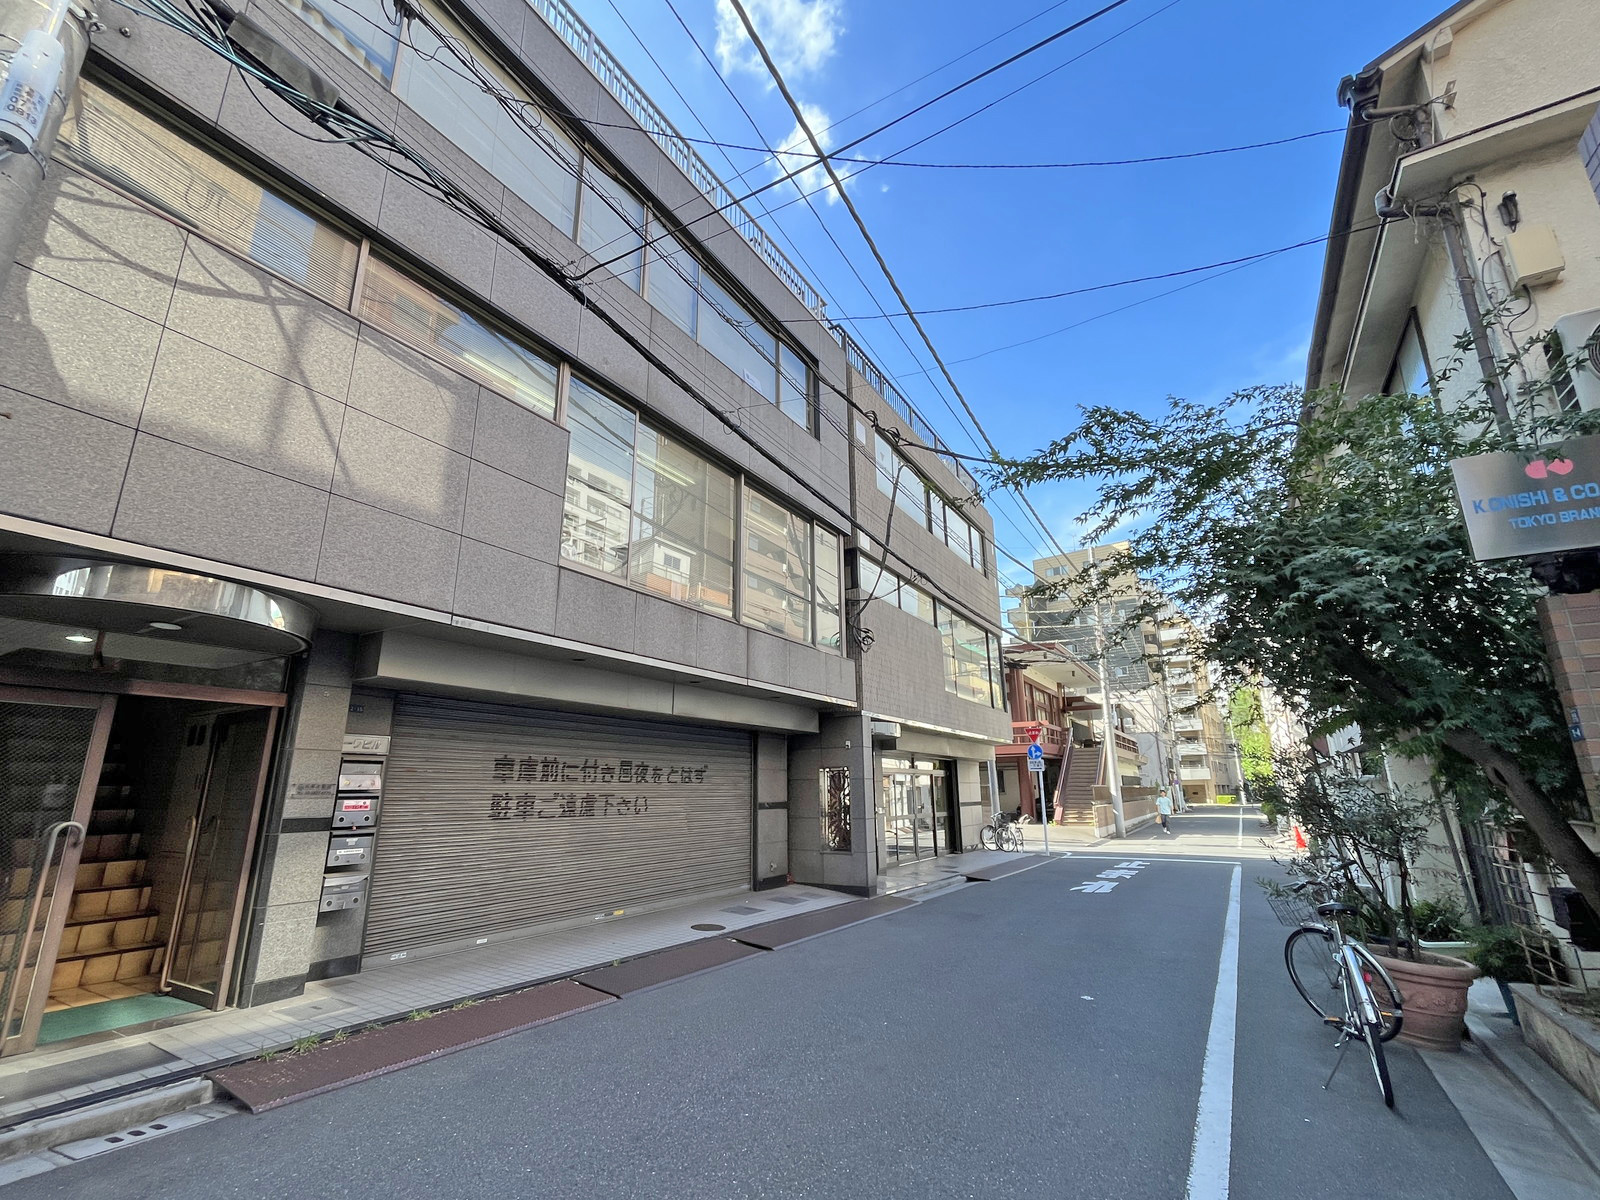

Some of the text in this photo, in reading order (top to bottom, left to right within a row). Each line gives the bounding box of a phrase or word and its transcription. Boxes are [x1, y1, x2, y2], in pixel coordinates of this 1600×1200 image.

[1552, 487, 1569, 503] &
[1508, 513, 1556, 529] TOKYO
[1069, 860, 1150, 893] 止まれ
